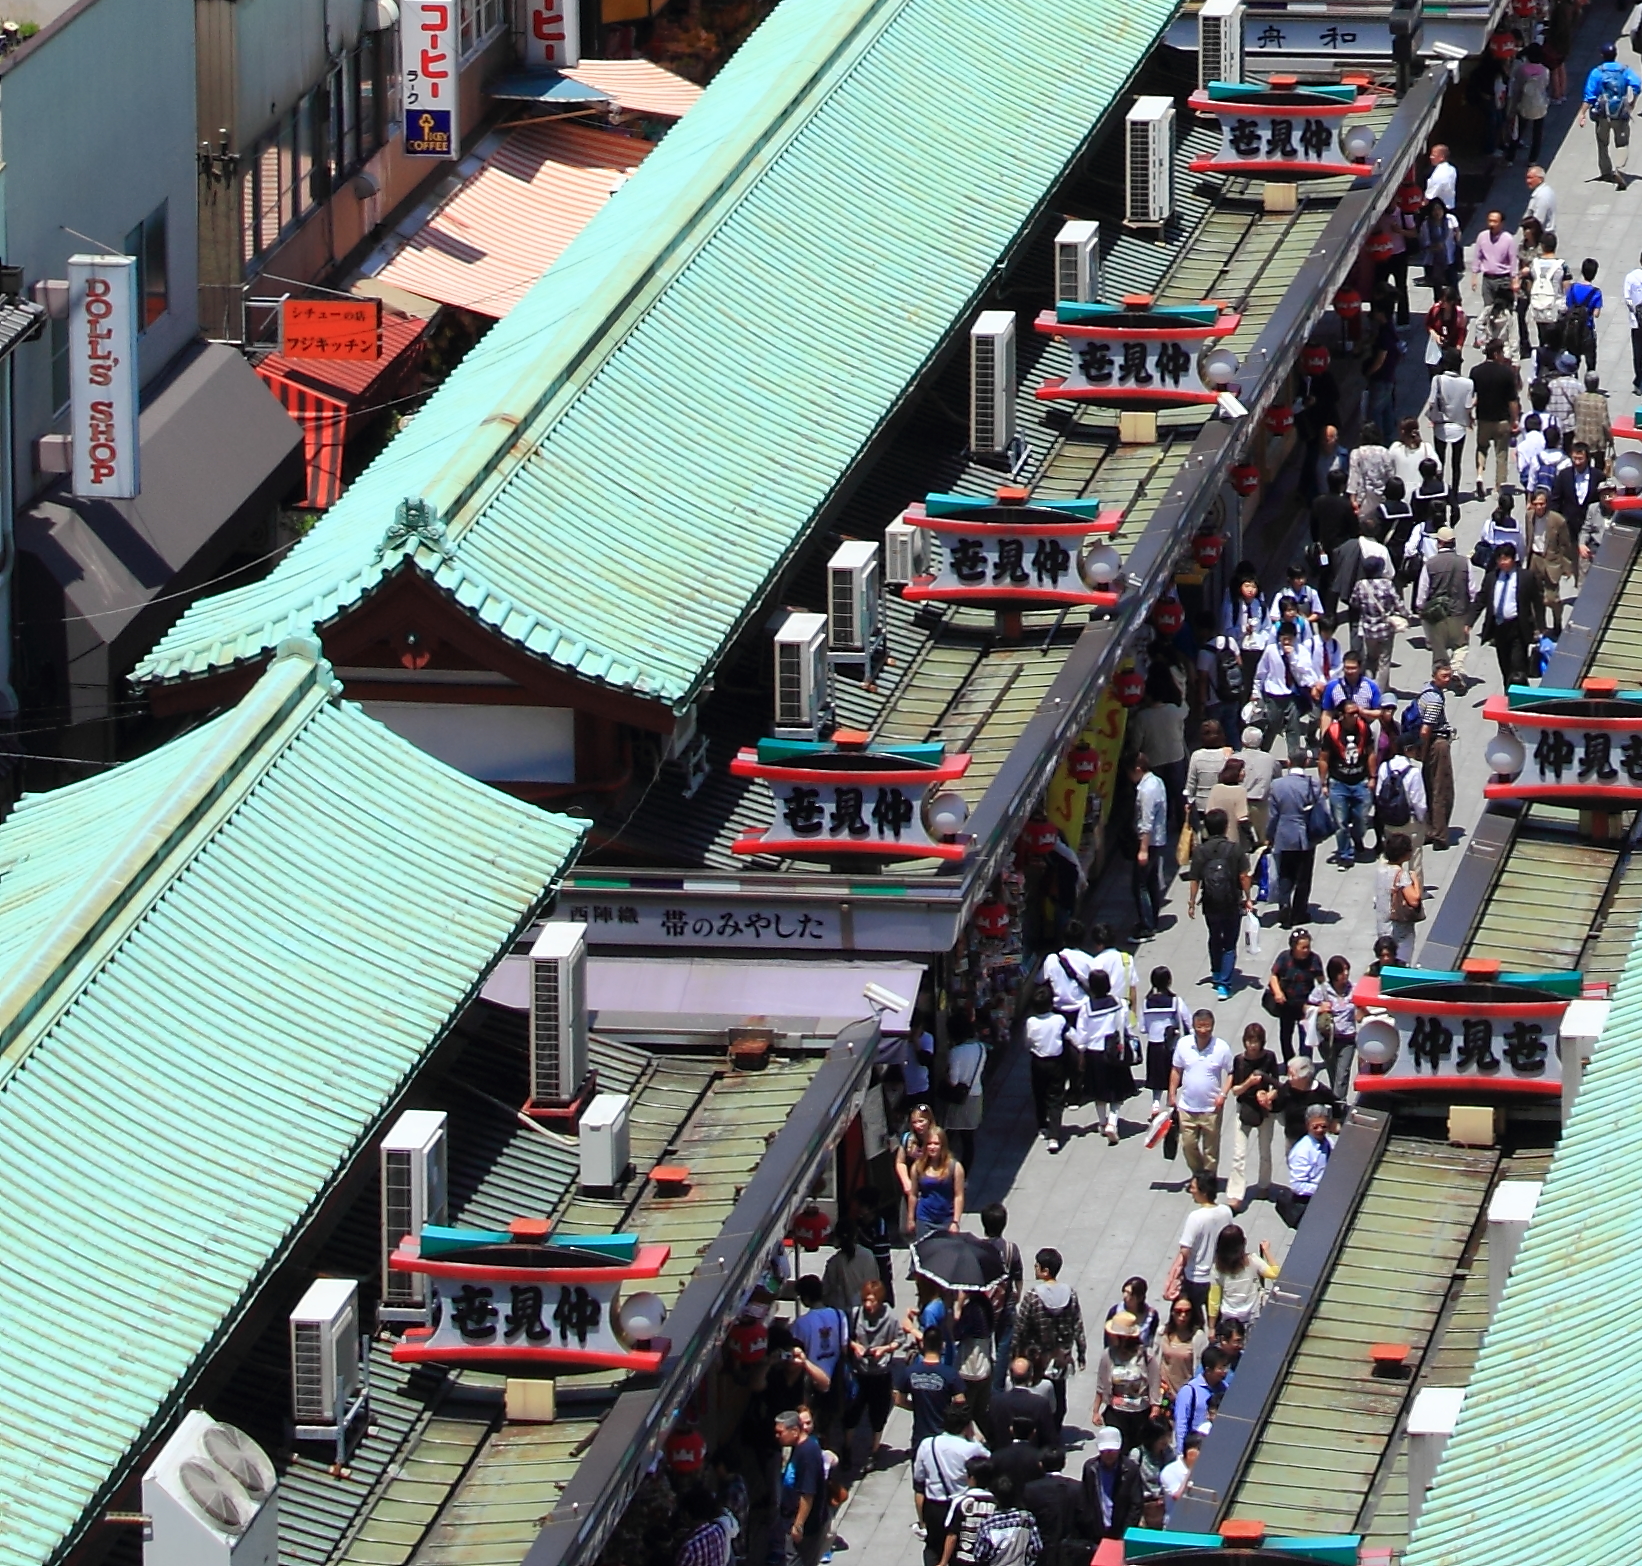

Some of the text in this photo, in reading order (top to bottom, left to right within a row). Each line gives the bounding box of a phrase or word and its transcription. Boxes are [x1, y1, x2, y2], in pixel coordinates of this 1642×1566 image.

[420, 4, 449, 99] コーヒー
[1258, 25, 1357, 50] 舟和
[406, 70, 420, 105] ラーク
[407, 141, 449, 152] COFFEE
[286, 336, 375, 355] フジキッチン
[86, 278, 120, 485] DOLL'S SHOP
[568, 905, 640, 926] 西陣織
[660, 909, 824, 941] 帯のみやした
